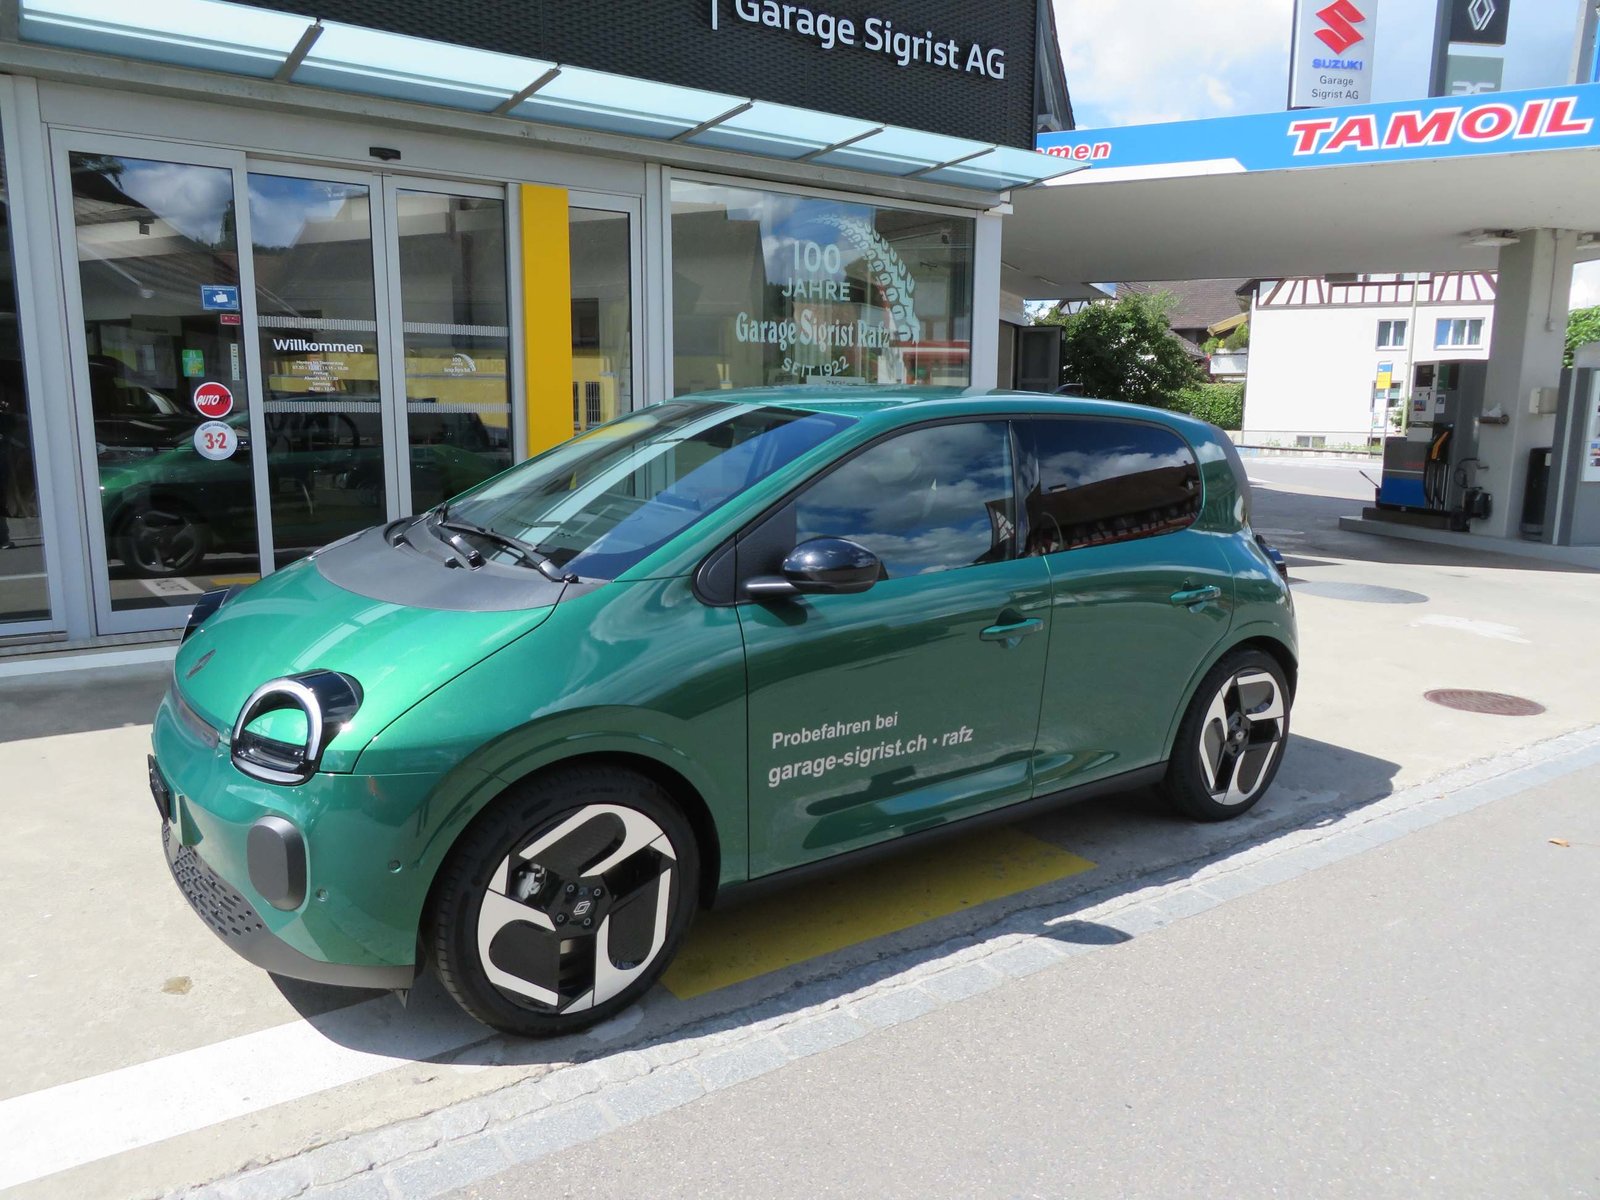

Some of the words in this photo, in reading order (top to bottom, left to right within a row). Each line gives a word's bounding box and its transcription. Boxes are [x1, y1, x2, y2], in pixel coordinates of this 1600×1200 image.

[735, 0, 855, 49] Garage
[864, 17, 959, 69] Sigrist
[965, 43, 1005, 79] AG
[1312, 58, 1363, 70] SUZUKI
[1311, 88, 1343, 100] Sigrist
[1345, 89, 1359, 100] AG
[1319, 75, 1354, 87] Garage
[1287, 96, 1594, 157] TAMOIL
[793, 239, 841, 275] 100
[781, 277, 851, 301] JAHRE
[735, 311, 797, 351] Garage
[800, 308, 854, 352] Sigrist
[857, 319, 890, 348] Rafz
[272, 338, 364, 353] Willkommen
[781, 357, 815, 377] SEIT
[819, 355, 849, 377] 1922
[772, 718, 871, 749] Probefahren
[875, 711, 899, 730] bei
[768, 733, 927, 788] garage-sigrist.ch
[942, 725, 974, 747] rafz
